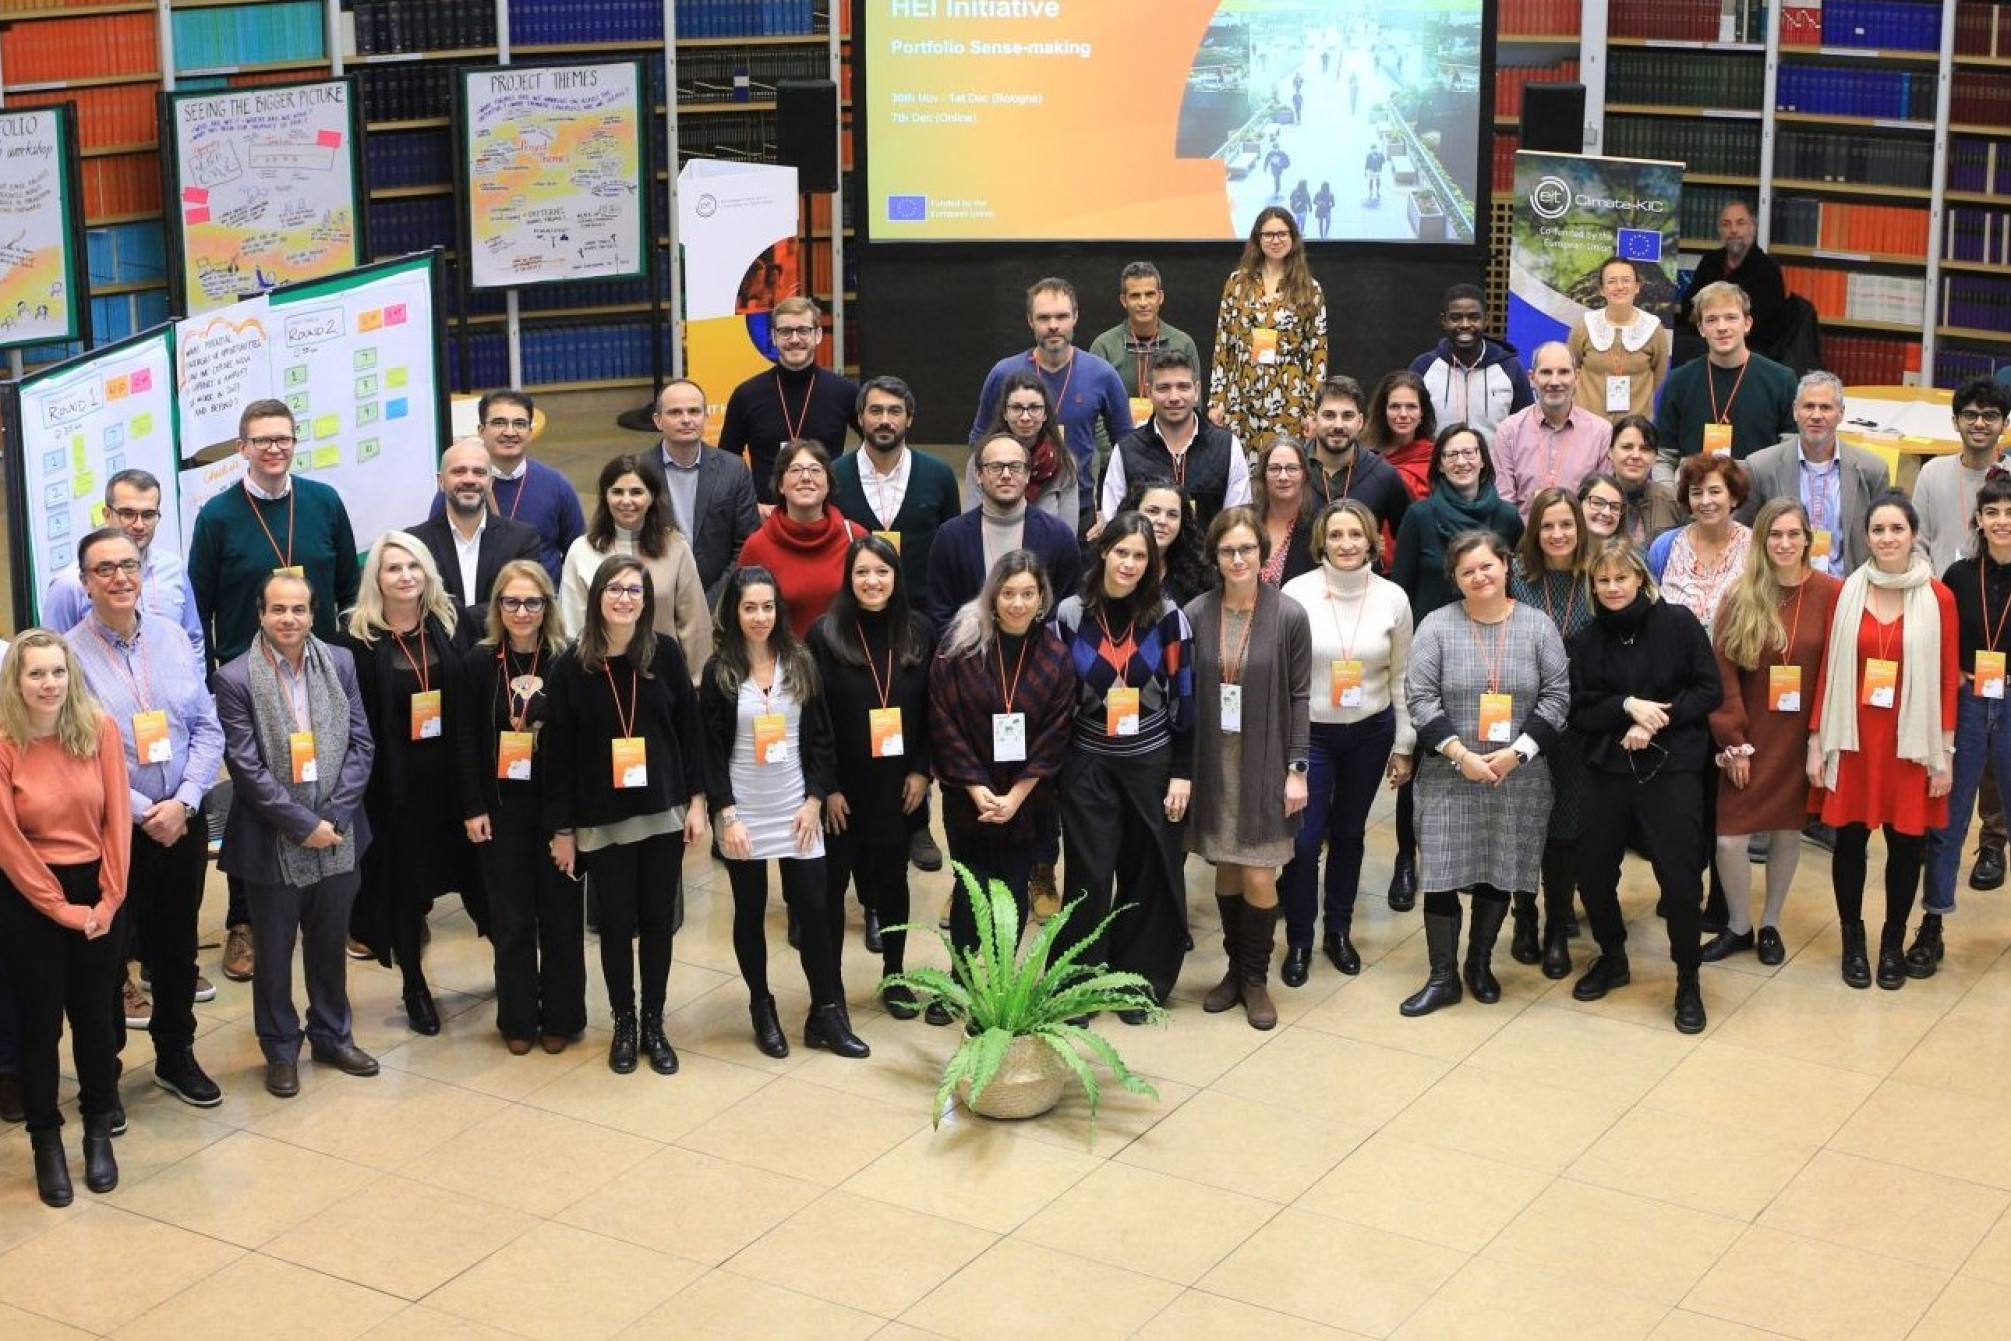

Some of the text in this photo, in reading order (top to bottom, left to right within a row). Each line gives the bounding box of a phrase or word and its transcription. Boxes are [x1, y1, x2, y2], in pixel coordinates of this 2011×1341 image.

[891, 0, 1060, 18] HEI Initiative
[891, 39, 1091, 58] Portfolio Sense-making
[491, 70, 598, 93] PROJECT THEMES
[184, 86, 343, 122] SEEING THE BIGGER PICTURE
[1574, 194, 1664, 213] Climate-KIC
[326, 320, 336, 335] 2
